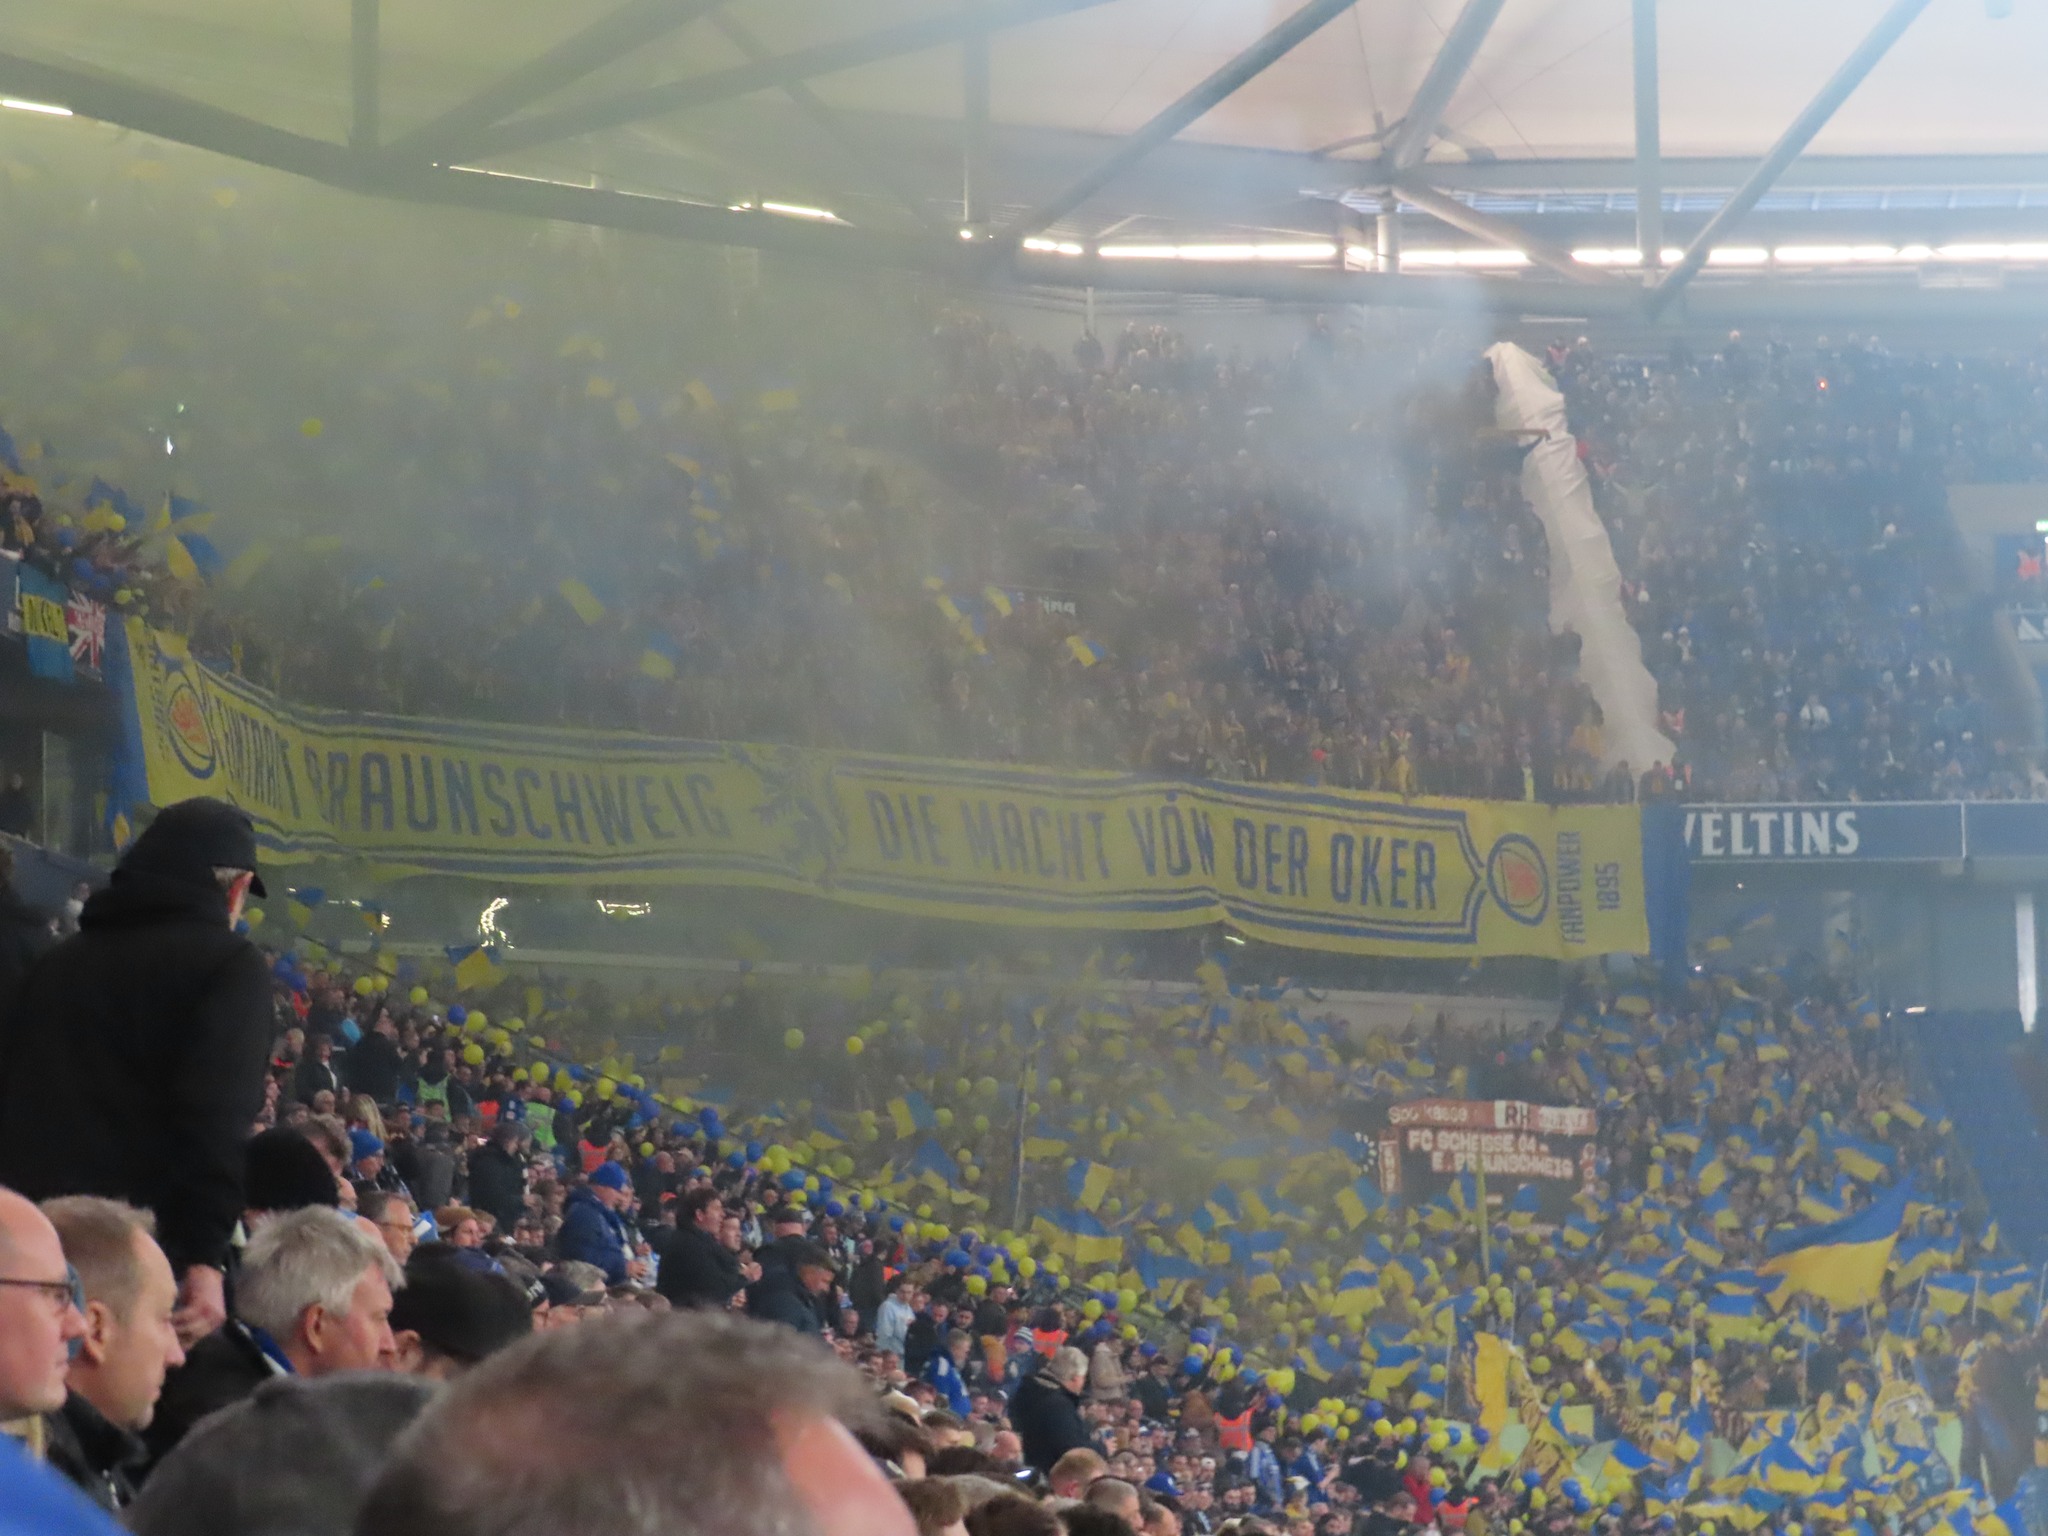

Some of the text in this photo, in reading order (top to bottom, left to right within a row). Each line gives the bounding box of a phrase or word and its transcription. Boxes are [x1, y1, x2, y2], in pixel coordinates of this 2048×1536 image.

[866, 789, 950, 867] DIE
[961, 800, 1110, 881] MACHT
[1233, 817, 1309, 897] DER
[1330, 832, 1437, 911] OKER
